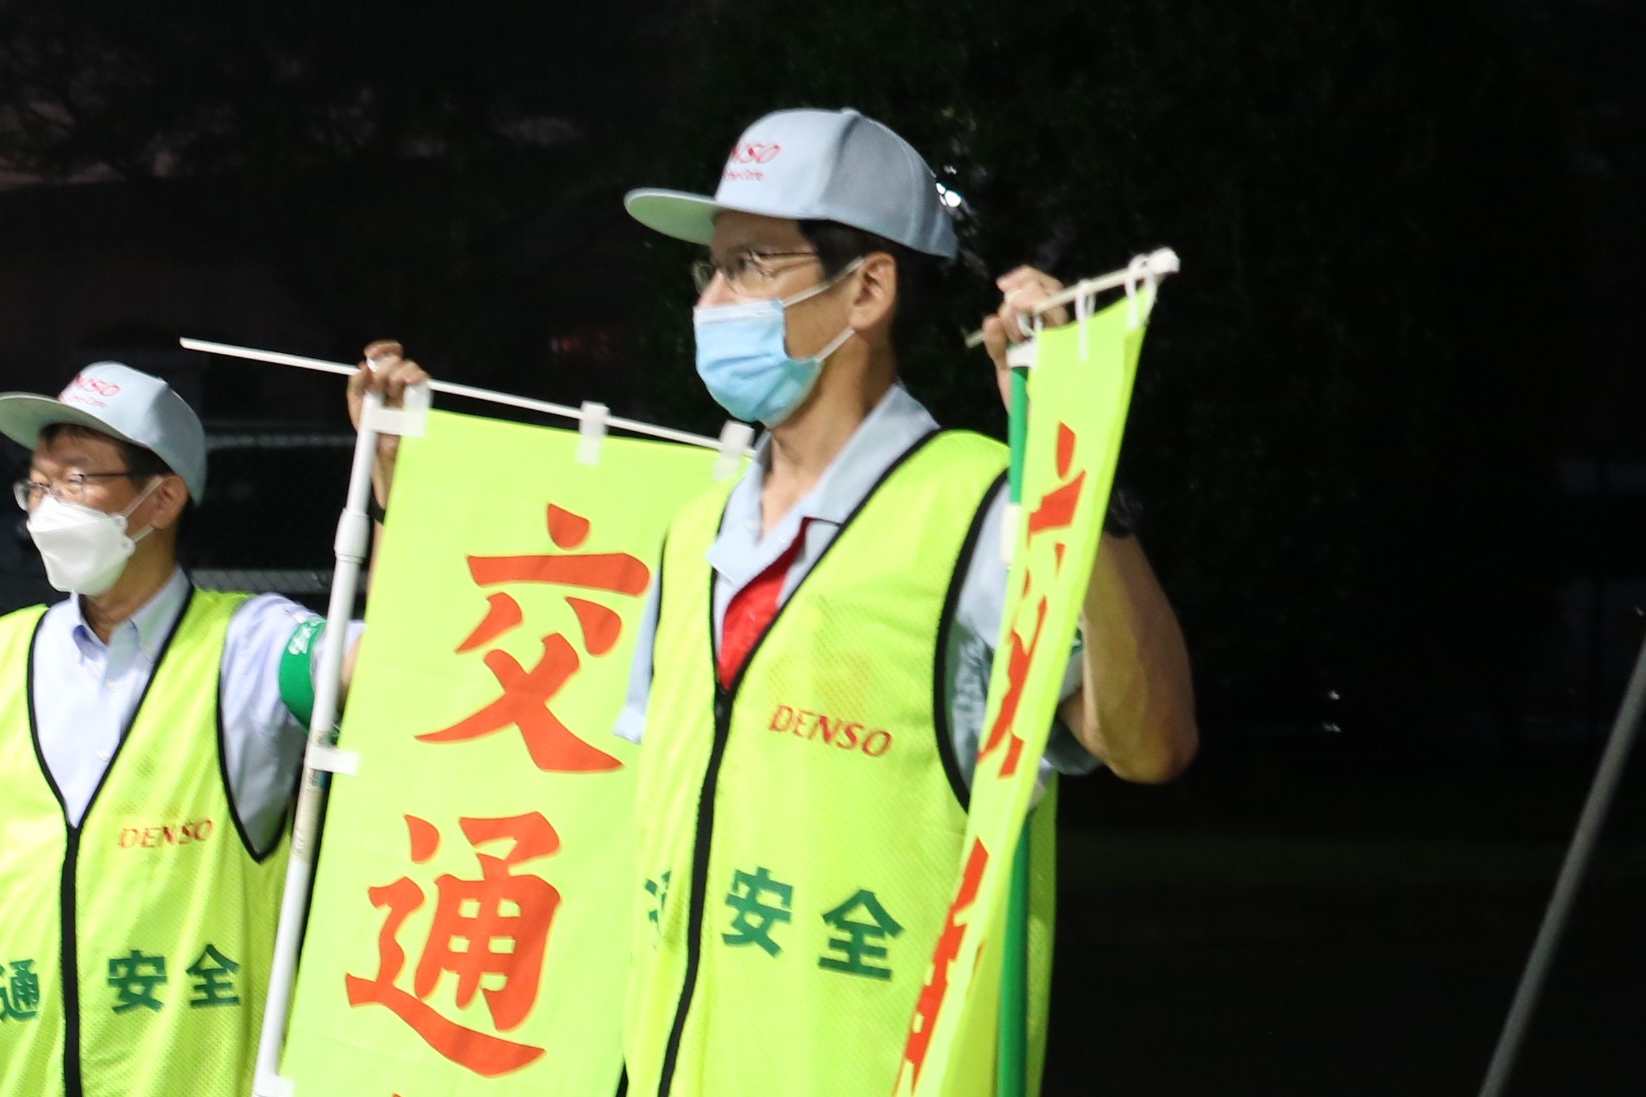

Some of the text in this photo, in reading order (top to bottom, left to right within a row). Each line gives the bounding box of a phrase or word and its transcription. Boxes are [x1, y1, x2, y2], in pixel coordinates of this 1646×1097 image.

[769, 704, 893, 758] DENSO
[119, 818, 213, 849] DENSO
[722, 866, 906, 982] 安全
[108, 943, 242, 1014] 安全
